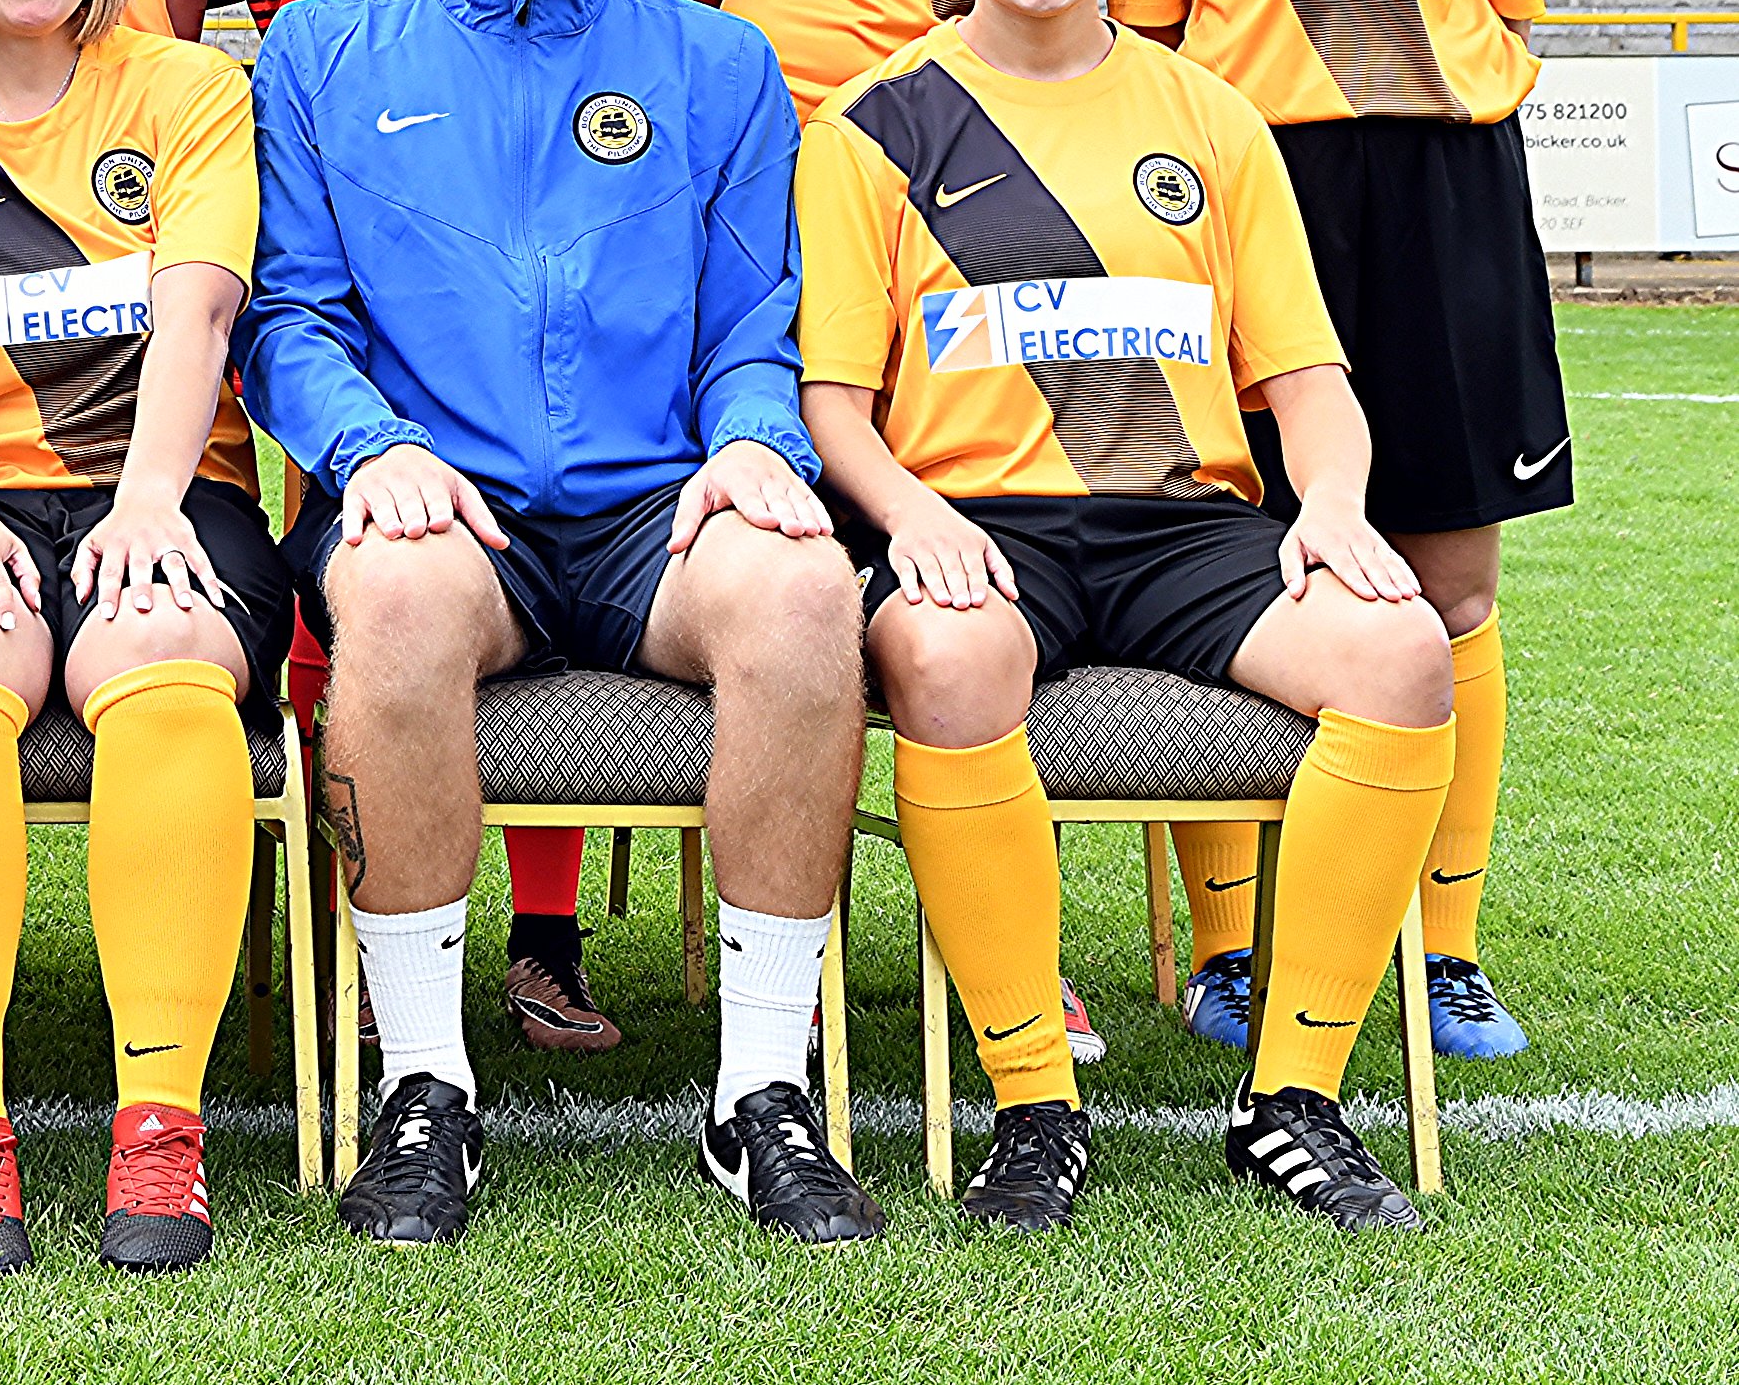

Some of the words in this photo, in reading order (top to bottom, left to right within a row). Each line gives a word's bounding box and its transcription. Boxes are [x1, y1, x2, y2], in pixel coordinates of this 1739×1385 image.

[581, 99, 608, 129] BOSTON
[615, 99, 643, 125] UNITED
[1553, 103, 1627, 120] 821200
[18, 269, 73, 297] CV
[1014, 280, 1067, 312] CV
[1020, 327, 1209, 365] ELECTRICAL
